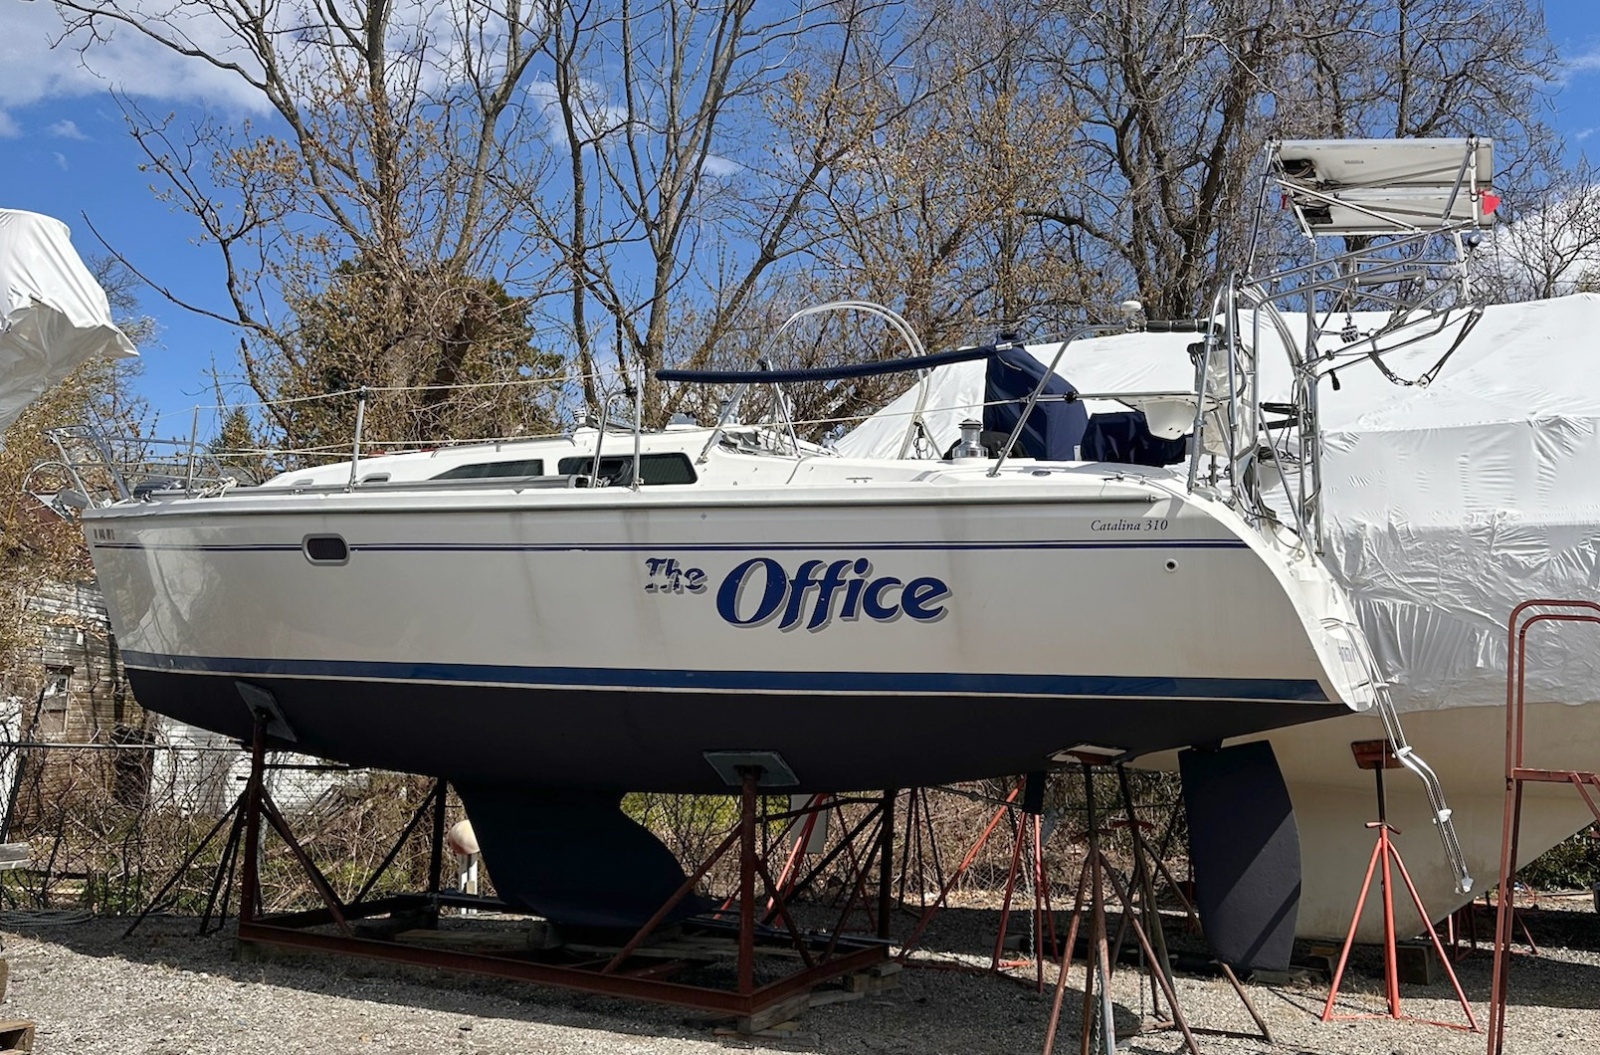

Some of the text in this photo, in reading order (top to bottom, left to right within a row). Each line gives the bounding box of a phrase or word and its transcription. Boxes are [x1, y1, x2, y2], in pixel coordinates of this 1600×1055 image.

[1090, 519, 1168, 531] Catalina 310
[644, 556, 952, 634] The Office
